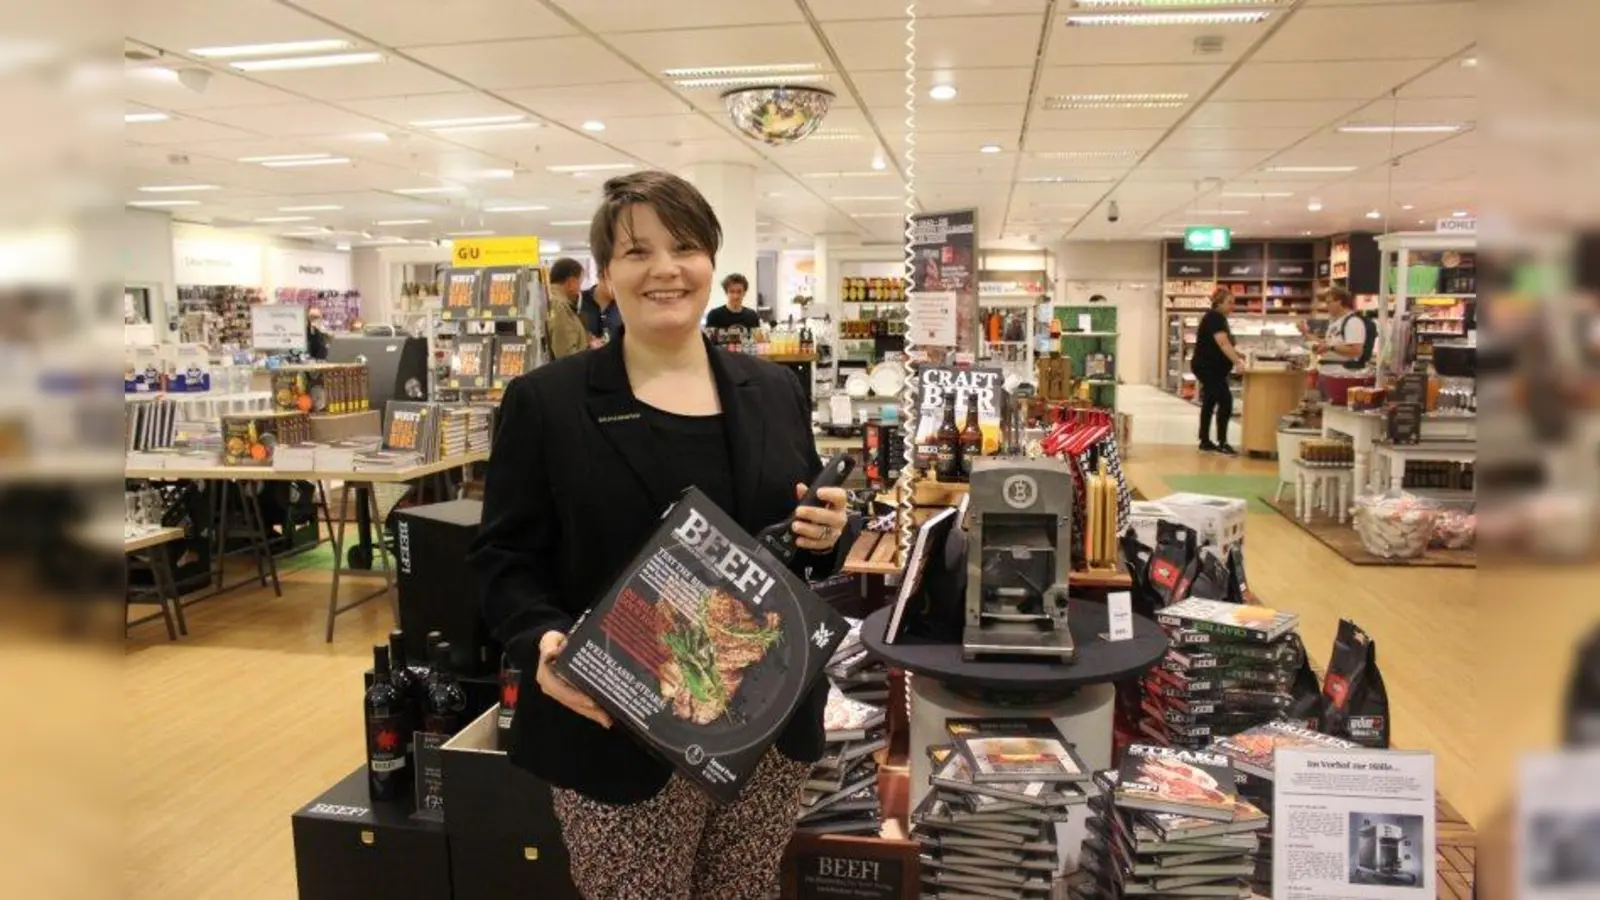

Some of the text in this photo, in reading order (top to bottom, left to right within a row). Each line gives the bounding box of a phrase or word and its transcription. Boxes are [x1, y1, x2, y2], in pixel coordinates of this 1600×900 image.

[922, 369, 999, 390] CRAFT
[673, 507, 776, 605] BEEF!
[308, 803, 370, 816] BEEF!
[819, 857, 880, 881] BEEF!
